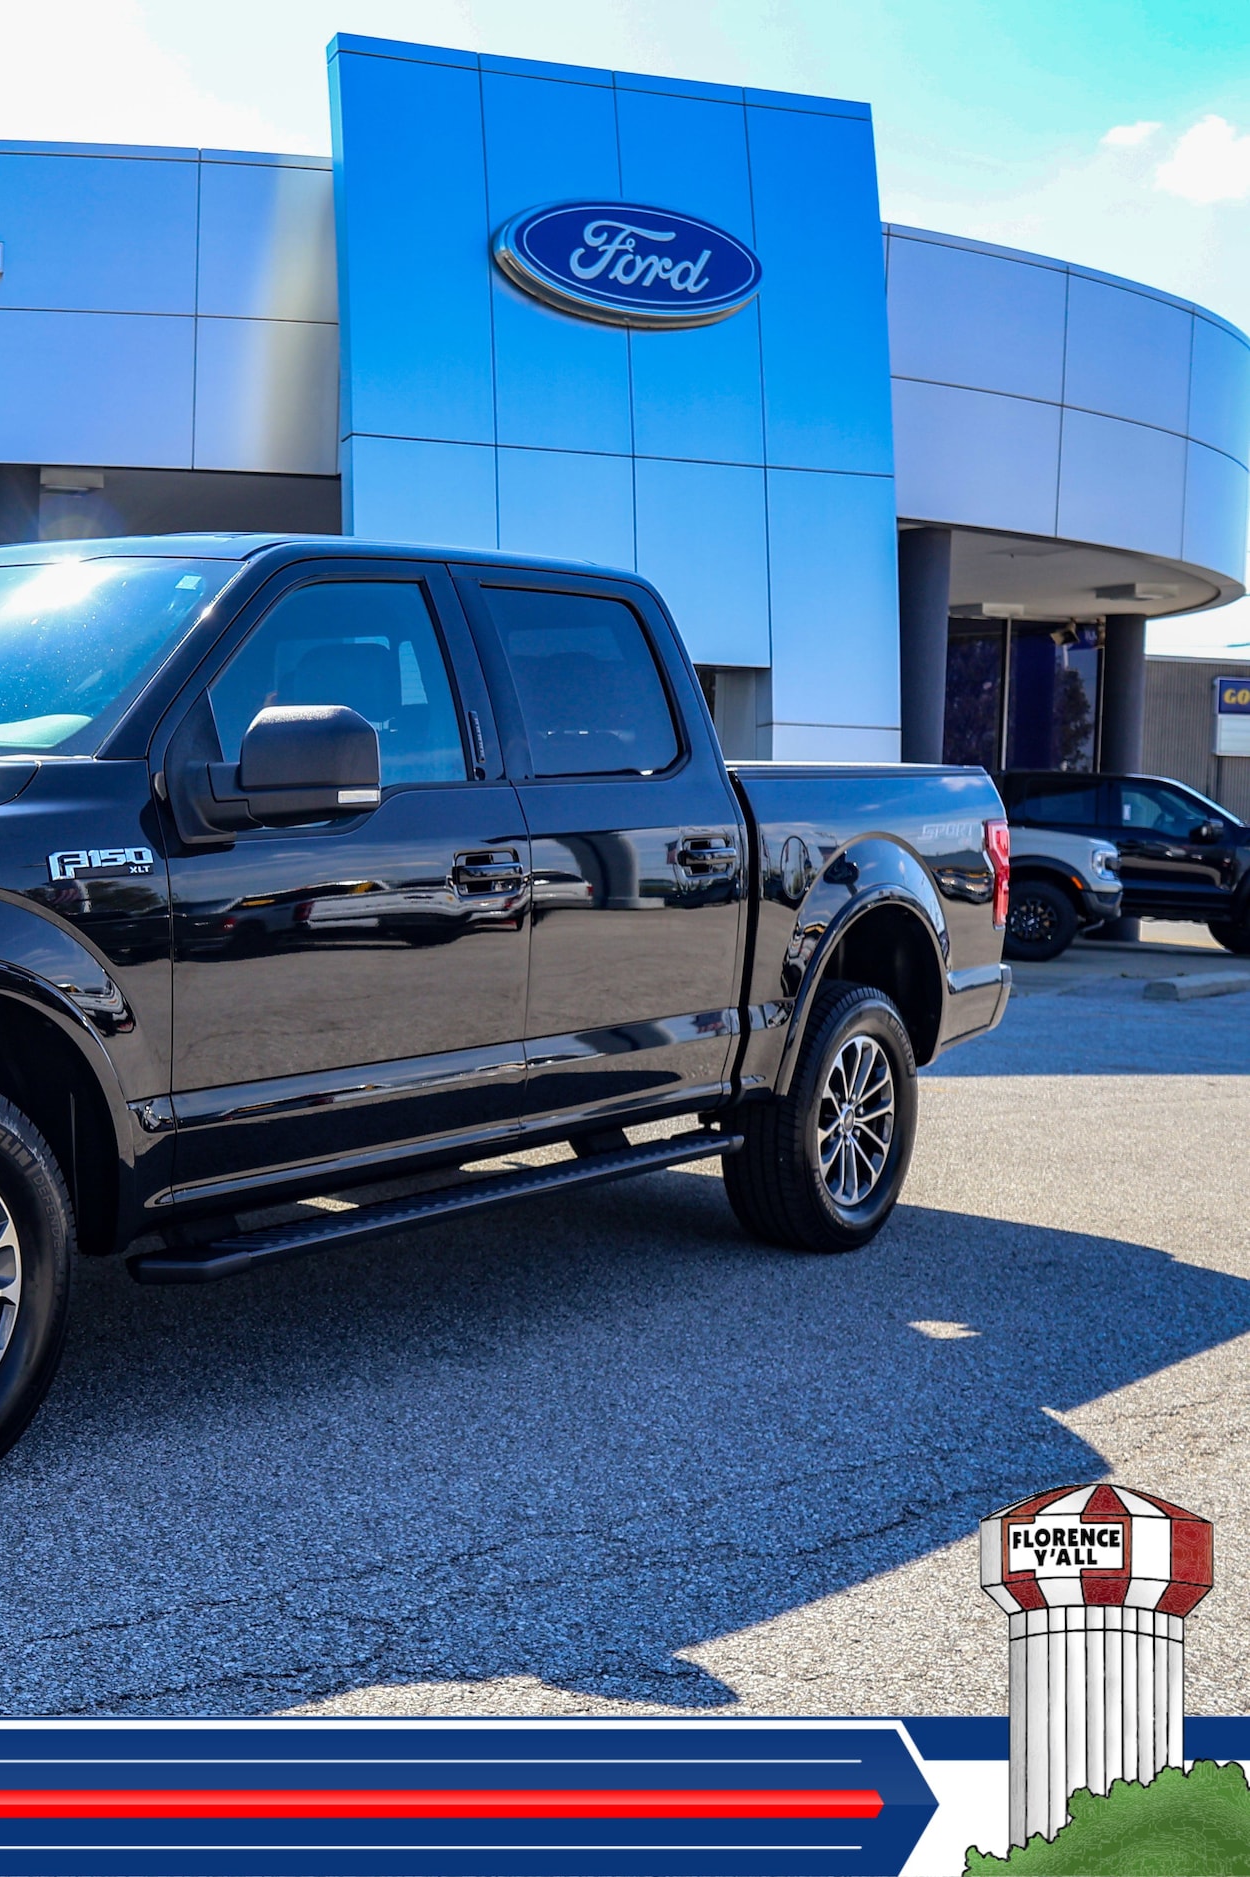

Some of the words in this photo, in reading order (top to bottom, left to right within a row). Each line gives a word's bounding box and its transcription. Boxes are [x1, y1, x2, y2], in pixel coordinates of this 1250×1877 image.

[569, 220, 712, 294] Ford
[917, 823, 974, 841] SPORT
[129, 865, 150, 874] XLT
